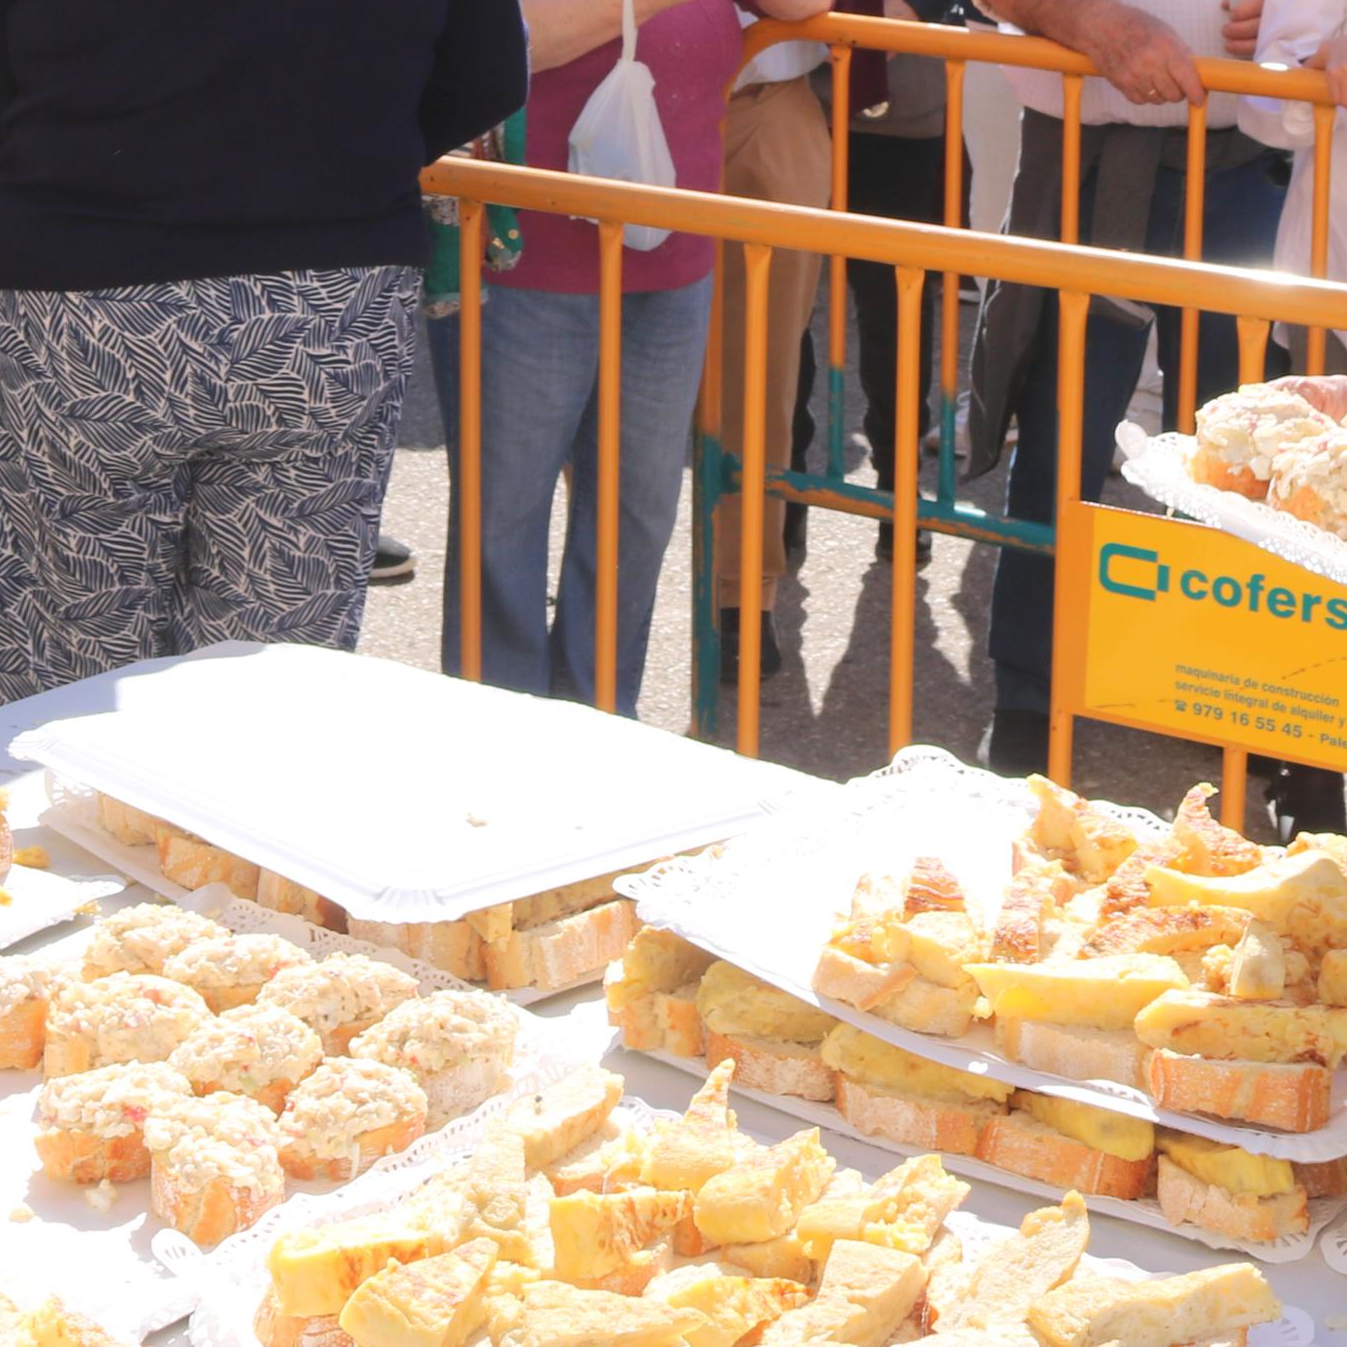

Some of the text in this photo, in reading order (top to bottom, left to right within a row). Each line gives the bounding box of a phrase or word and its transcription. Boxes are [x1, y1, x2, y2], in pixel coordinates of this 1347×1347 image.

[1176, 664, 1240, 686] maquinaria
[1244, 678, 1258, 689] de
[1175, 681, 1220, 698] servicio
[1224, 689, 1268, 708] integral
[1272, 701, 1286, 713] de
[1290, 705, 1334, 723] alquiler
[1338, 717, 1346, 729] y
[1193, 702, 1223, 720] 979
[1231, 711, 1250, 726] 16
[1255, 716, 1276, 732] 55
[1282, 723, 1303, 738] 45
